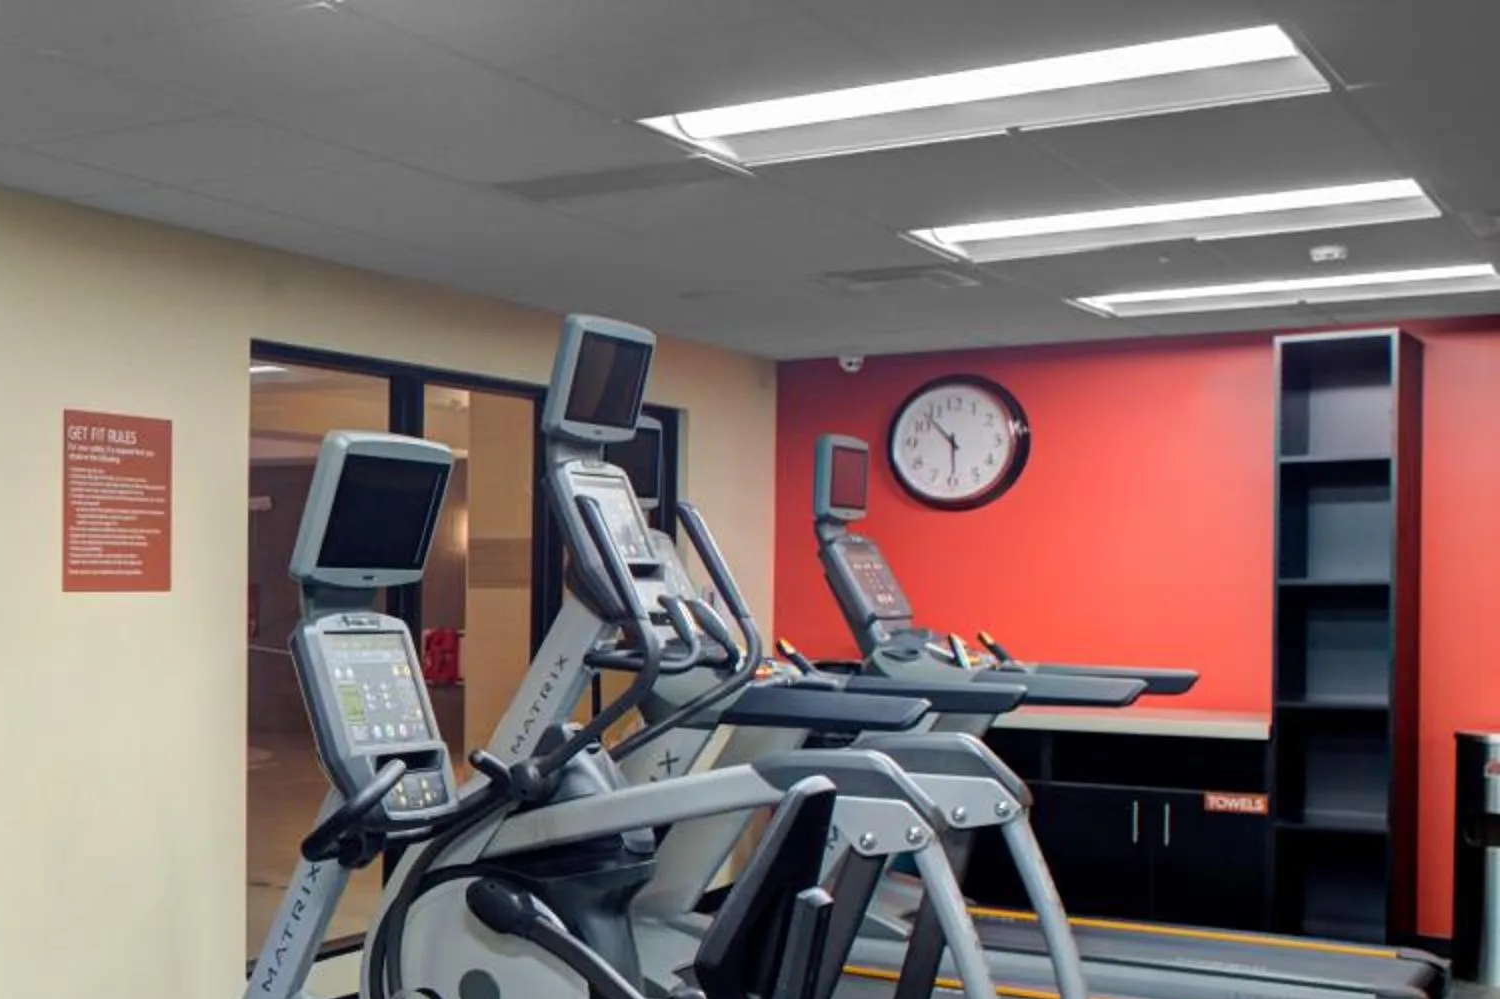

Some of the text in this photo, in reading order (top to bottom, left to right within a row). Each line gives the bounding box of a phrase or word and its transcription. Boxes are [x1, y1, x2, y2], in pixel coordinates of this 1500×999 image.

[67, 425, 138, 446] GET FIT RULES
[510, 655, 570, 754] MATRIX
[1207, 795, 1264, 813] TOWELS
[261, 863, 321, 992] MATRIX
